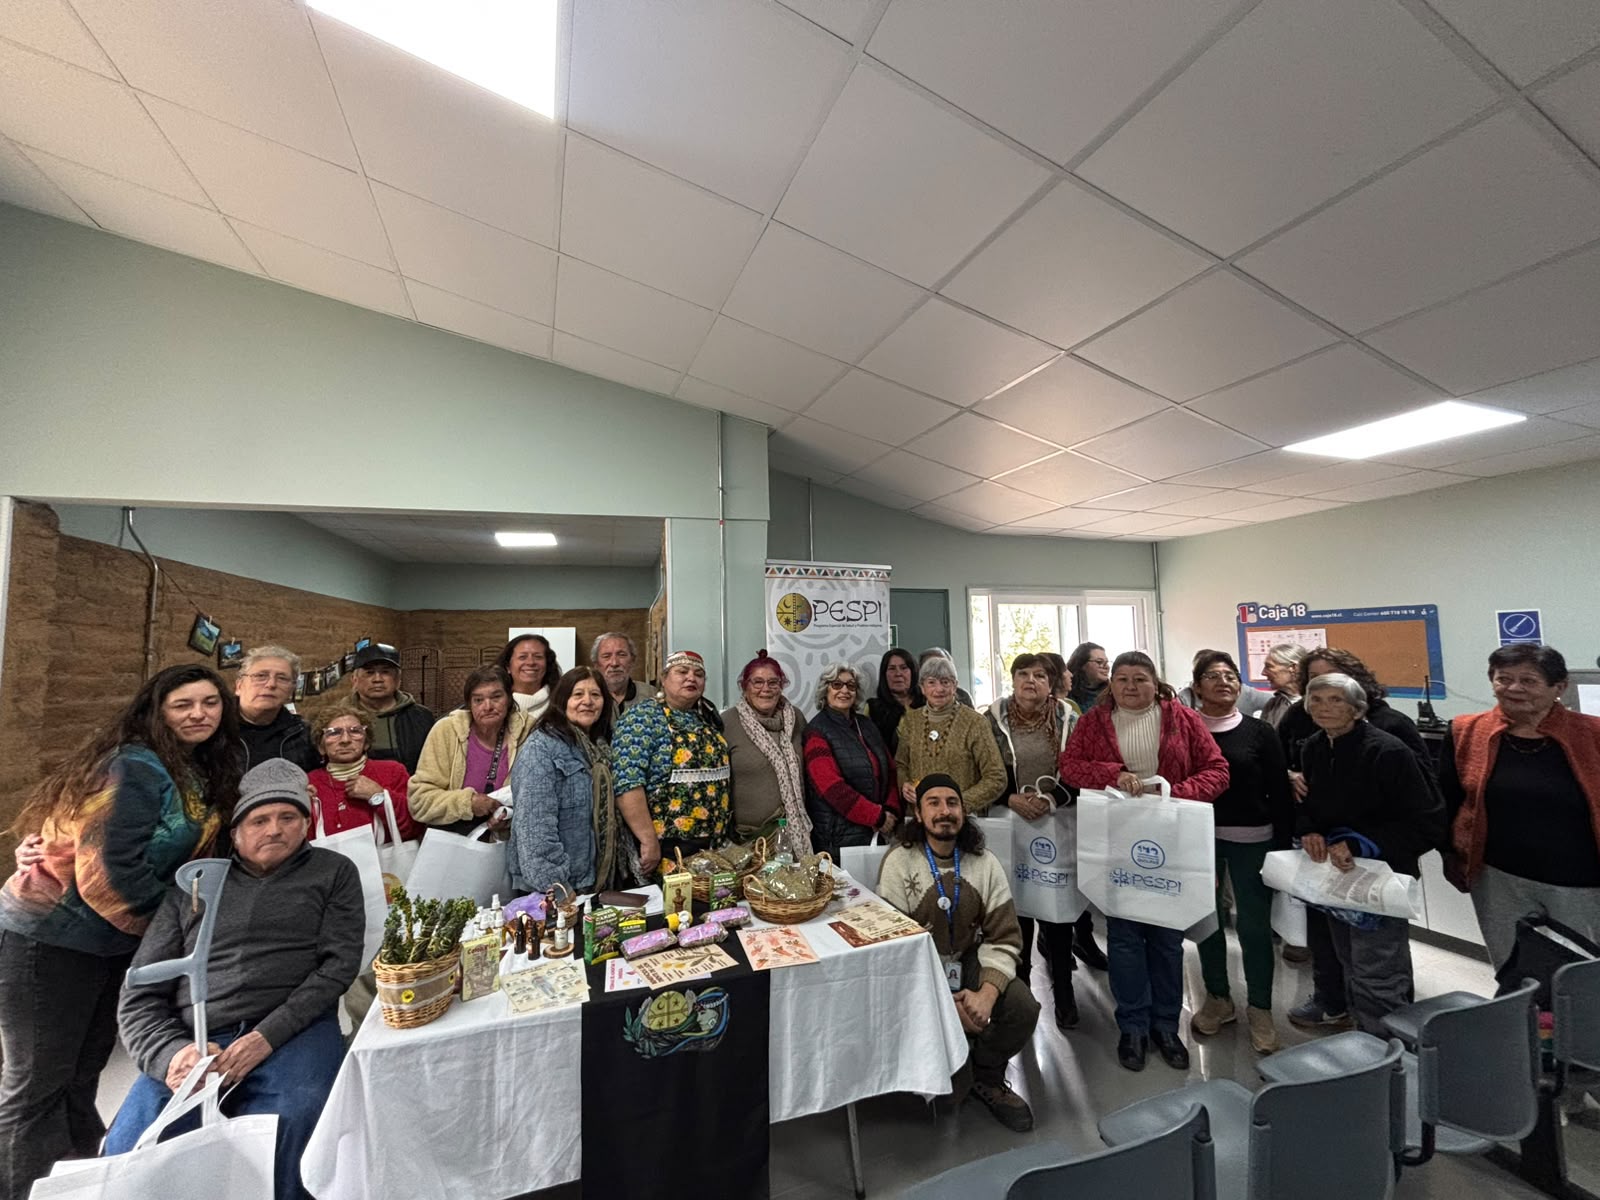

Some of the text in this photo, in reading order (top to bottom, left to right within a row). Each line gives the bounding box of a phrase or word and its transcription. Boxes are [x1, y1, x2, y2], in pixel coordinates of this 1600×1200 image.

[812, 600, 882, 622] PESPI
[1259, 604, 1306, 621] Caja 18
[1031, 868, 1068, 884] PESPI
[1132, 874, 1182, 893] PESPI
